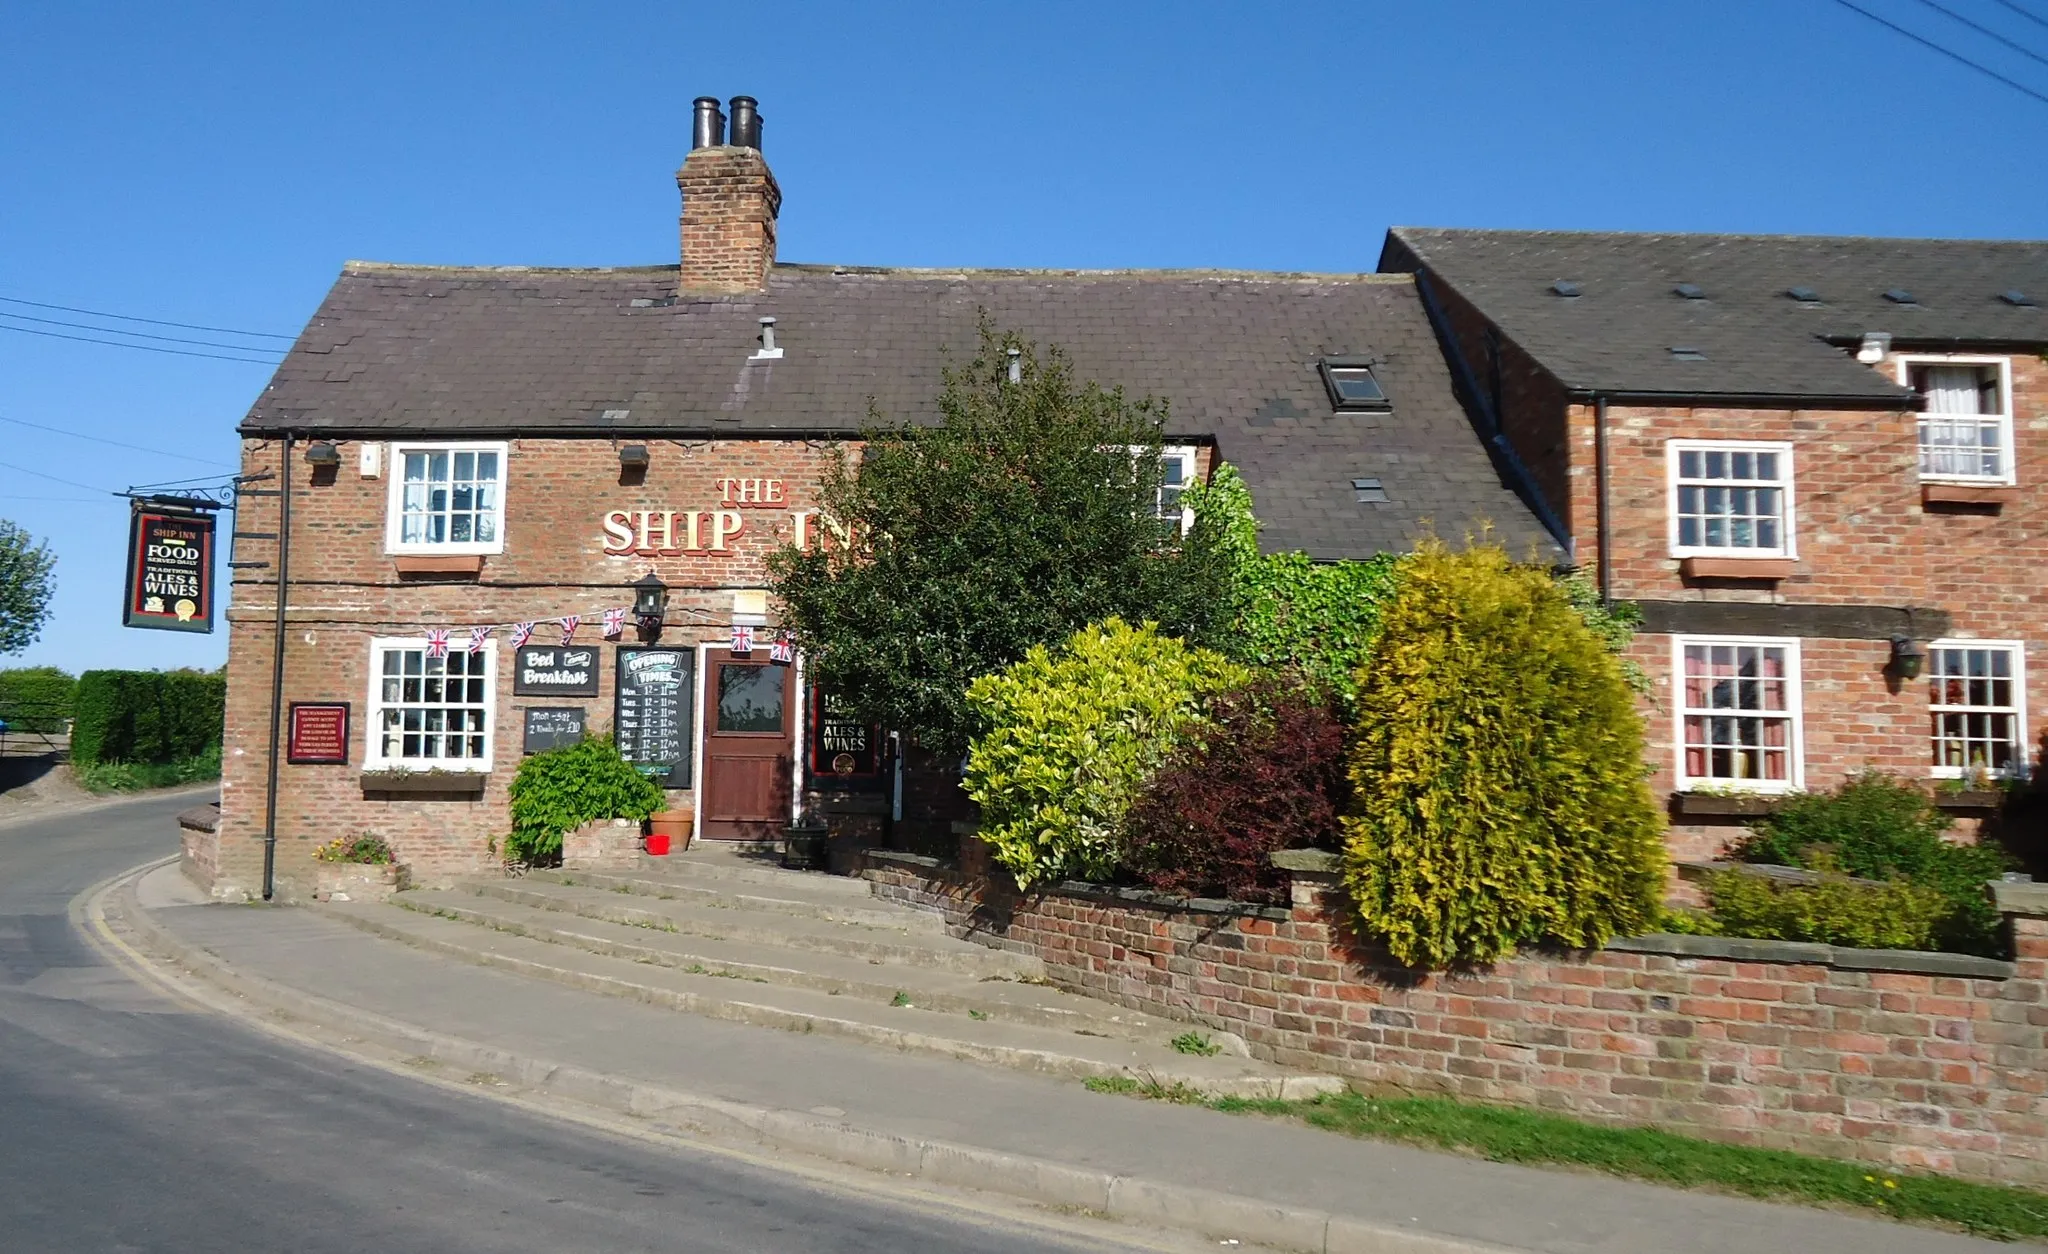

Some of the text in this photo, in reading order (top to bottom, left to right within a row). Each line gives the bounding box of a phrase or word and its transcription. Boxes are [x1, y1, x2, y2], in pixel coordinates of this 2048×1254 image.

[716, 478, 786, 507] THE
[153, 529, 196, 539] SHIP INN
[602, 510, 893, 555] SHIP IN
[148, 544, 199, 560] FOOD
[147, 566, 199, 575] TRADITIONAL
[145, 573, 198, 584] ALES &
[145, 582, 198, 596] WINES
[526, 652, 554, 667] Bed
[629, 654, 675, 670] OPENING
[523, 669, 588, 684] Breakfast
[529, 725, 535, 734] 2
[566, 721, 581, 733] £10
[824, 726, 865, 737] ALES &
[823, 737, 865, 751] WINES
